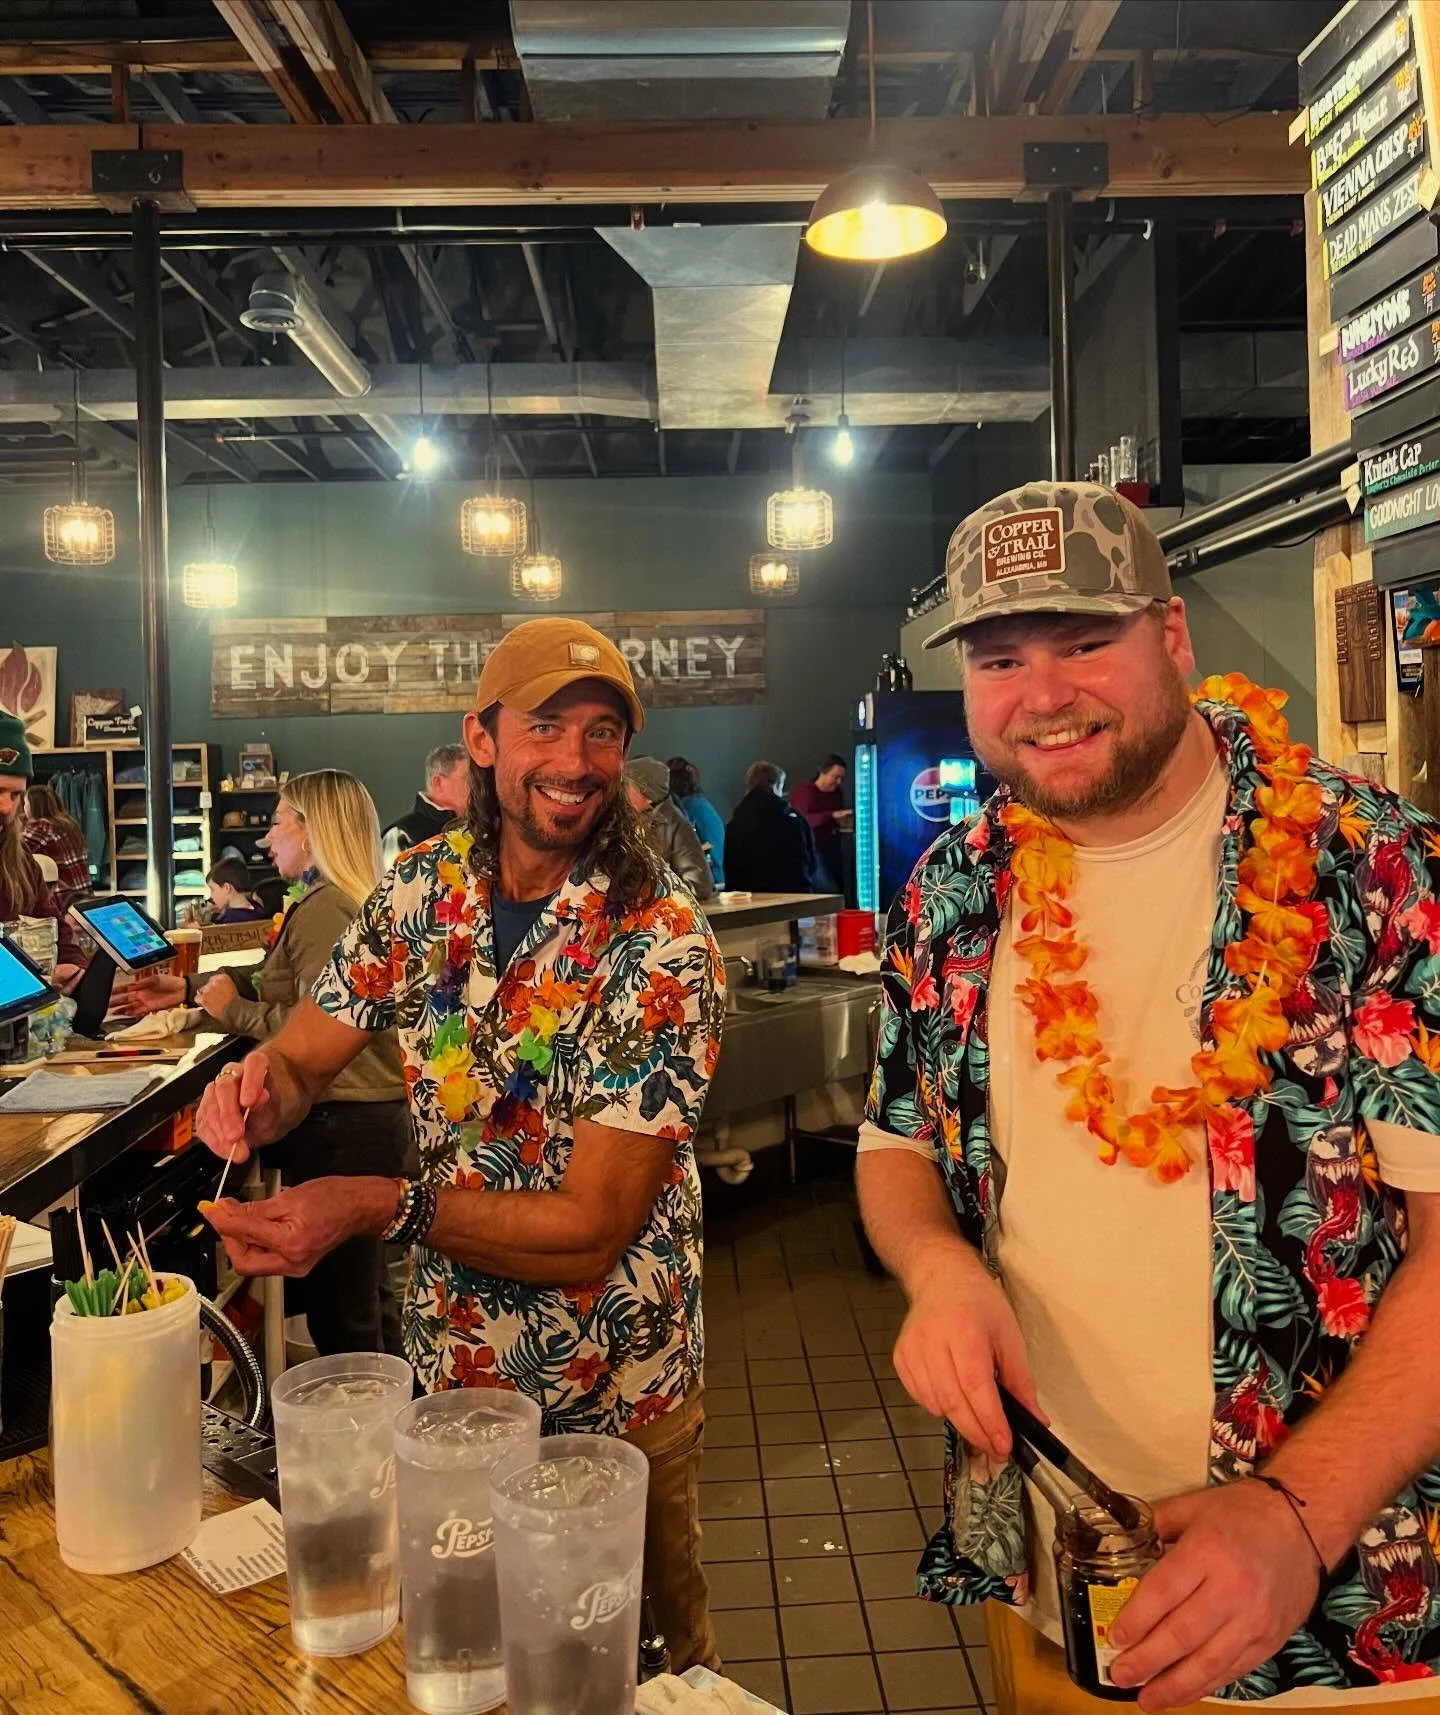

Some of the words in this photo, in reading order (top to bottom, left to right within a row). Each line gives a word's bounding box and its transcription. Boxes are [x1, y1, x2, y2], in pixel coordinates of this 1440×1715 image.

[1322, 153, 1376, 216] VIENNA
[1376, 123, 1408, 173] CRISP
[1329, 223, 1358, 265] DEAD
[1392, 173, 1419, 220] ZEST
[1348, 358, 1388, 401] Lucky
[1364, 449, 1399, 487] Knight
[1370, 488, 1423, 529] GOODNIGHT
[988, 519, 1054, 544] COPPER
[996, 551, 1031, 567] BREWING
[230, 639, 409, 690] ENJOY
